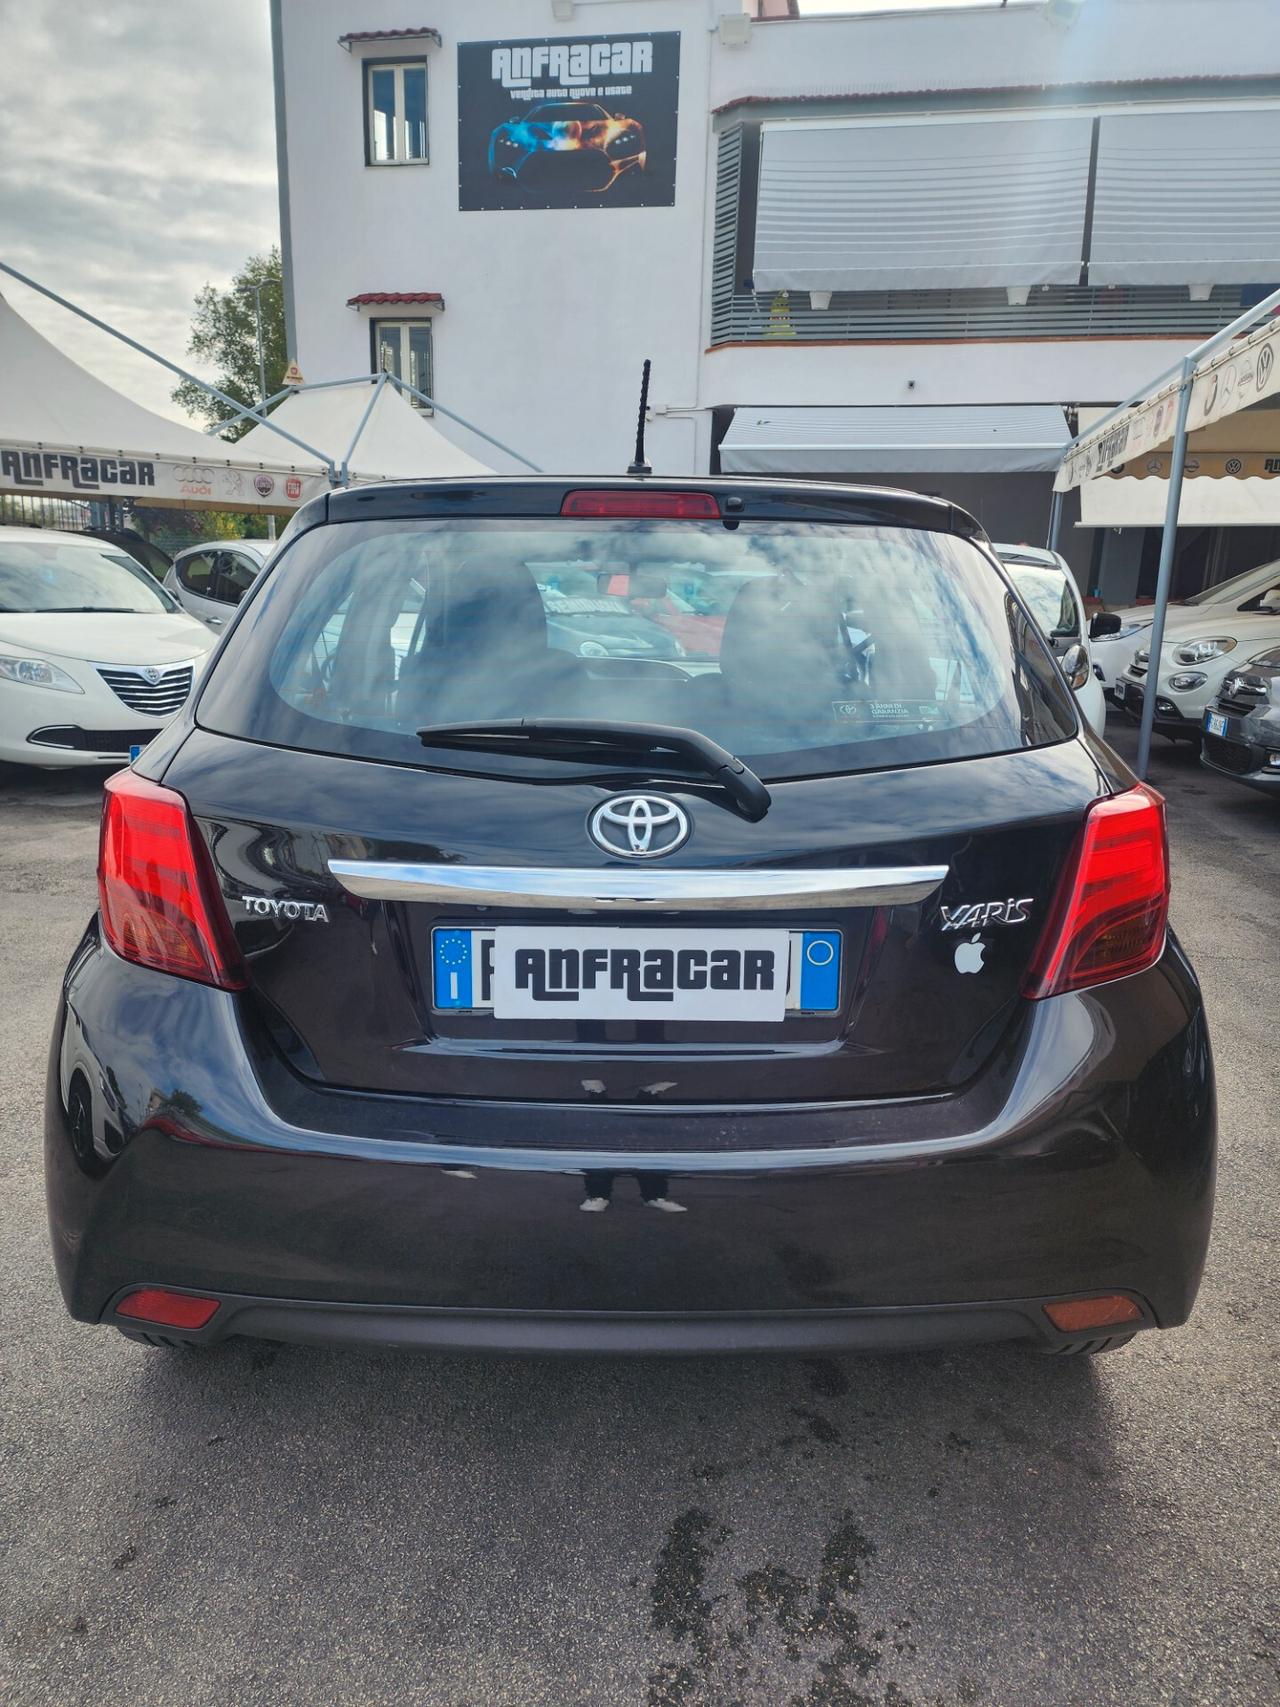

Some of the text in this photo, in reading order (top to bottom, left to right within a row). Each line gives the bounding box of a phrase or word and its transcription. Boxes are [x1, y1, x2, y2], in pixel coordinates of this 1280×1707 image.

[491, 41, 653, 87] ANFRACAR
[546, 88, 568, 98] auto
[1, 451, 155, 490] ANFRACAR
[241, 895, 329, 923] TOYOTA
[515, 949, 775, 1001] ANFRACAR
